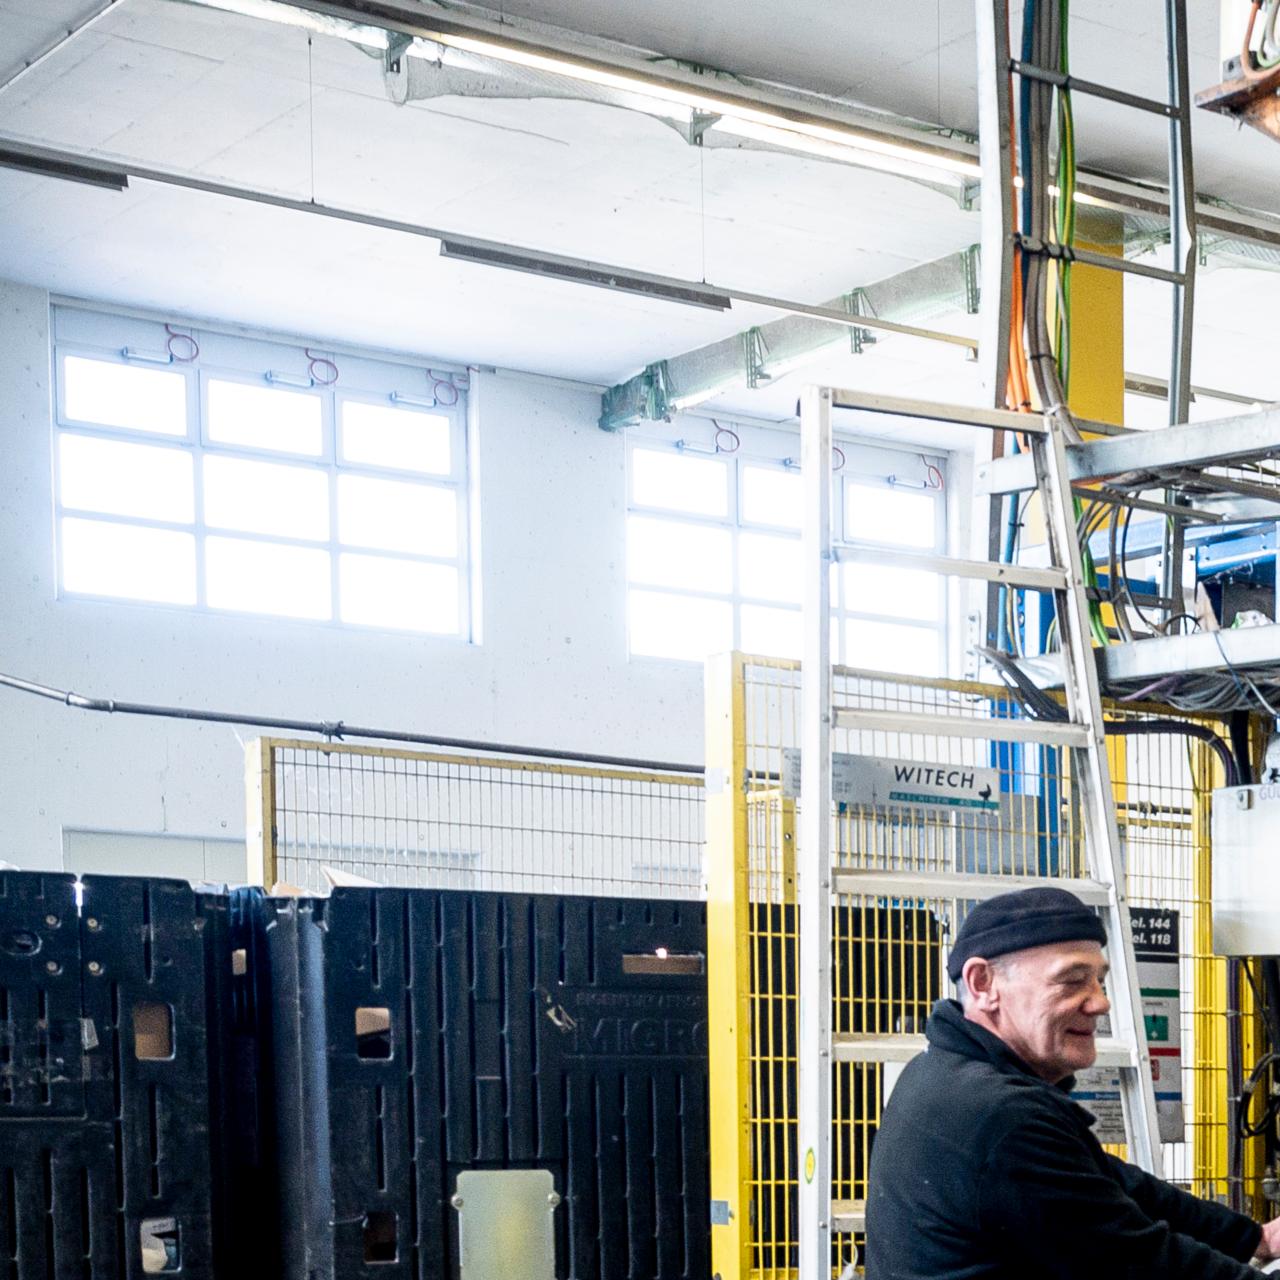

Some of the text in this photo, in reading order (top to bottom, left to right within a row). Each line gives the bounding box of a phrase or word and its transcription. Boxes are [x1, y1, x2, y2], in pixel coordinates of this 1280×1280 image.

[894, 764, 975, 789] WITECH
[1131, 917, 1171, 929] el. 144
[1132, 932, 1171, 945] el. 118
[573, 1018, 708, 1052] MIGRO
